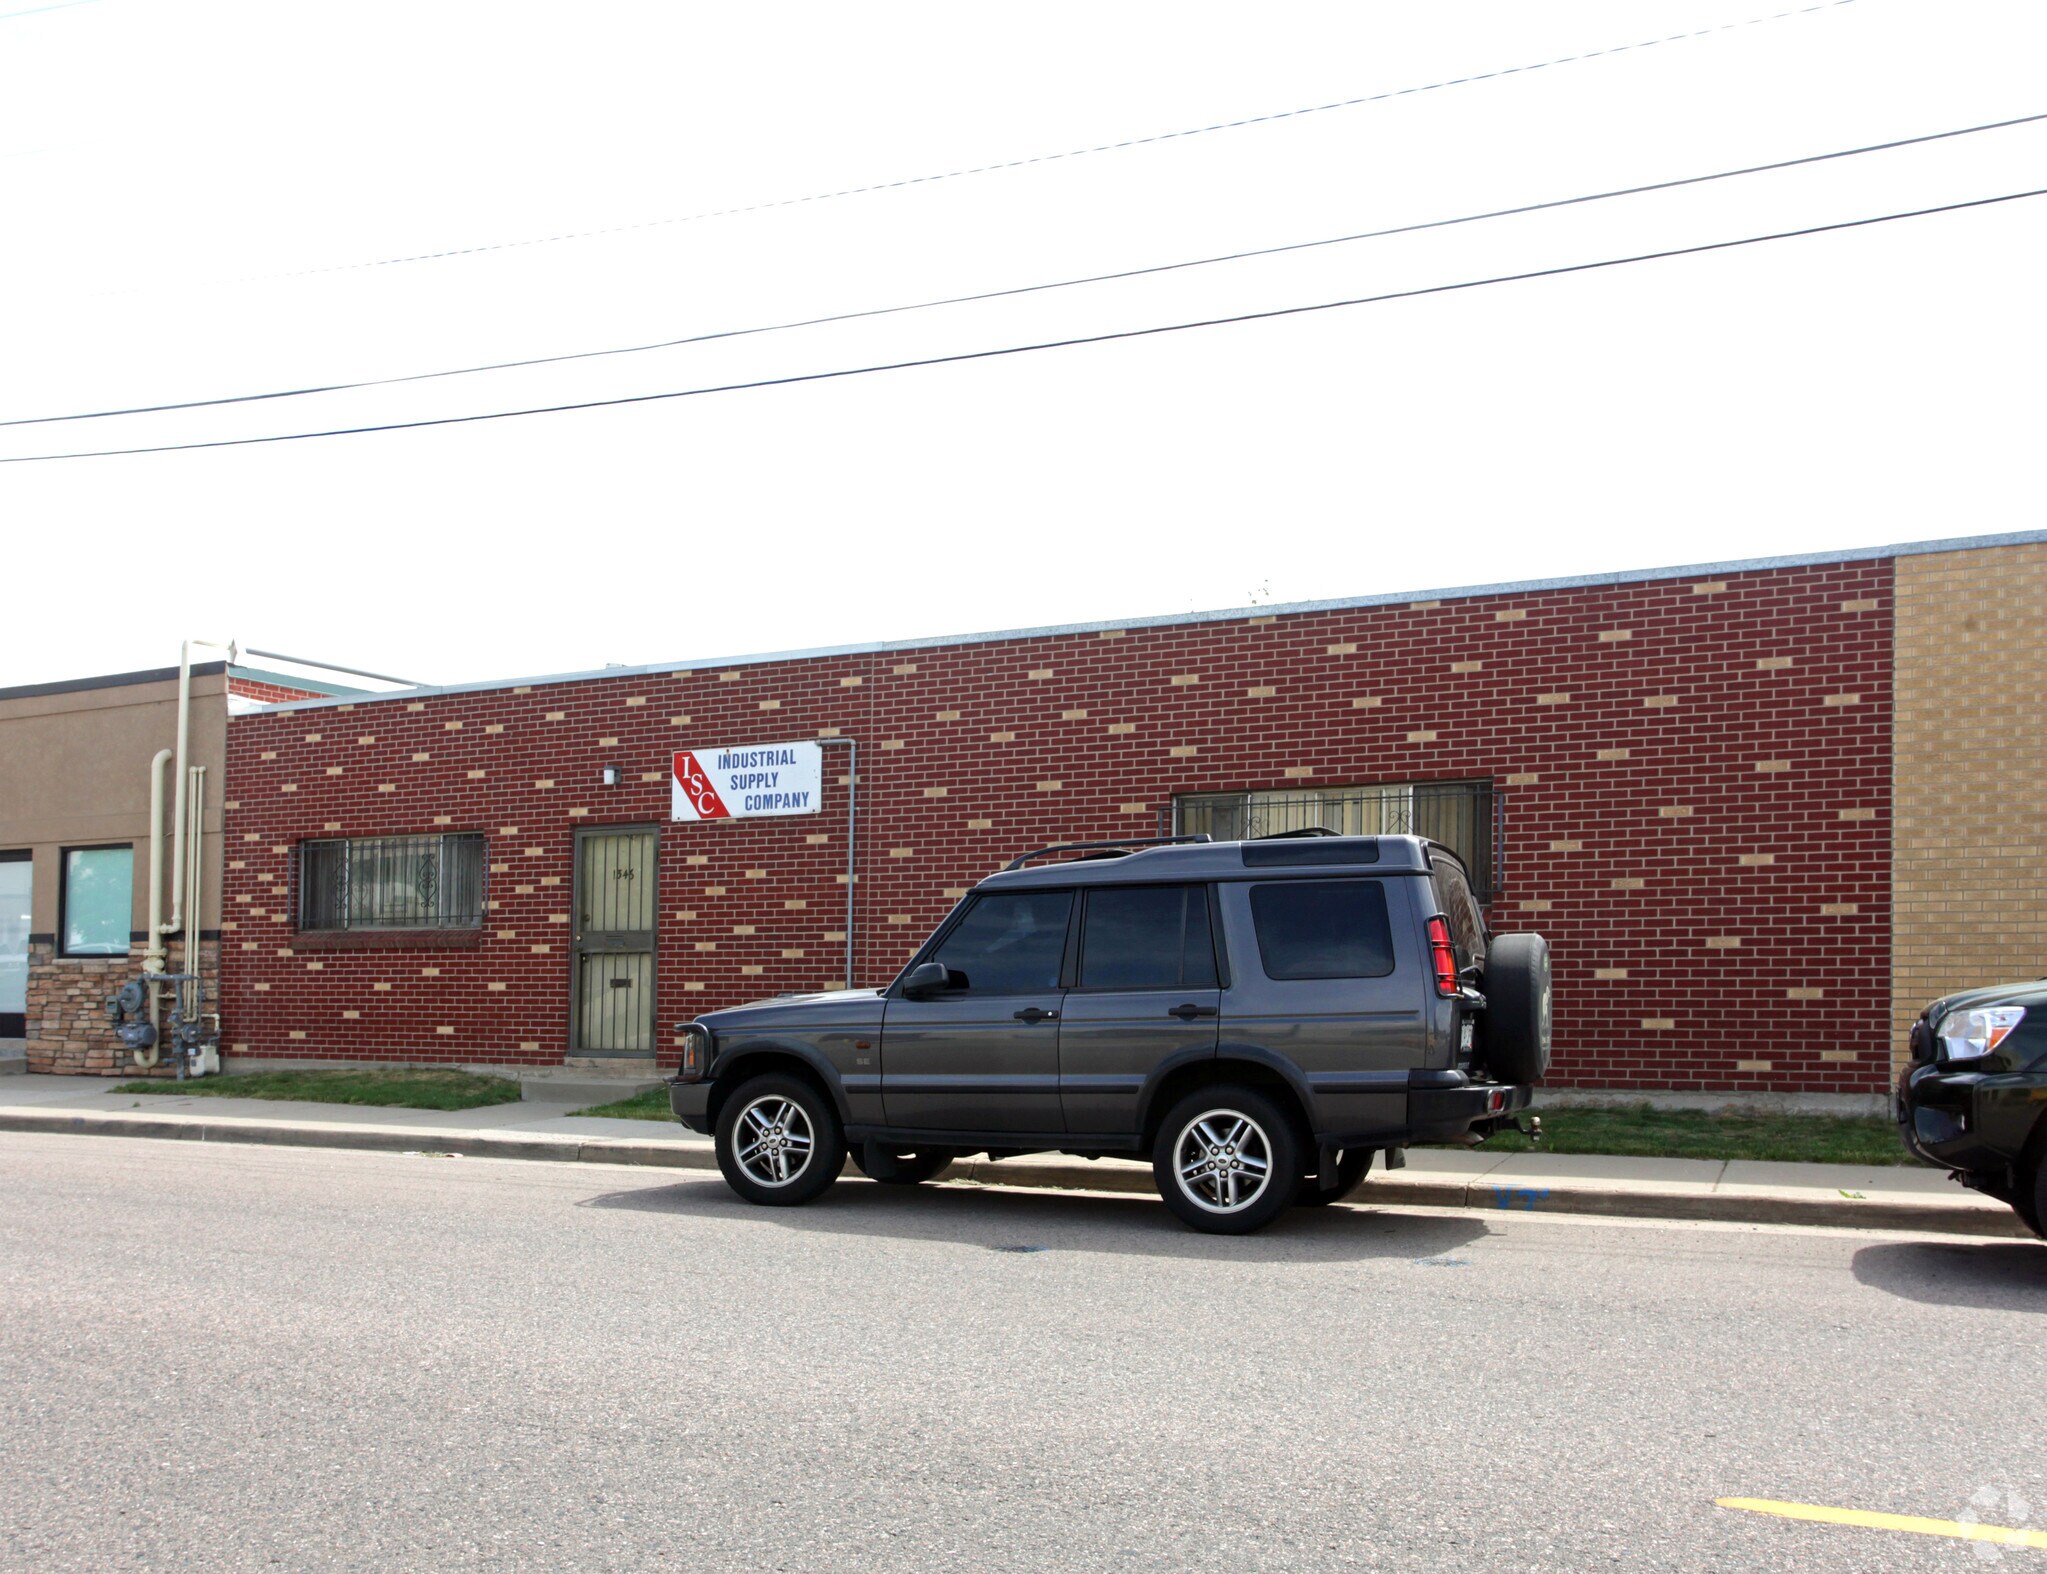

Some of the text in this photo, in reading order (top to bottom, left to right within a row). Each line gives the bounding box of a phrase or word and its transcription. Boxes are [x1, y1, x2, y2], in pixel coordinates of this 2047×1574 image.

[718, 749, 796, 770] INDUSTRIAL
[682, 756, 715, 814] ISC
[730, 772, 779, 790] SUPPLY
[745, 791, 809, 811] COMPANY
